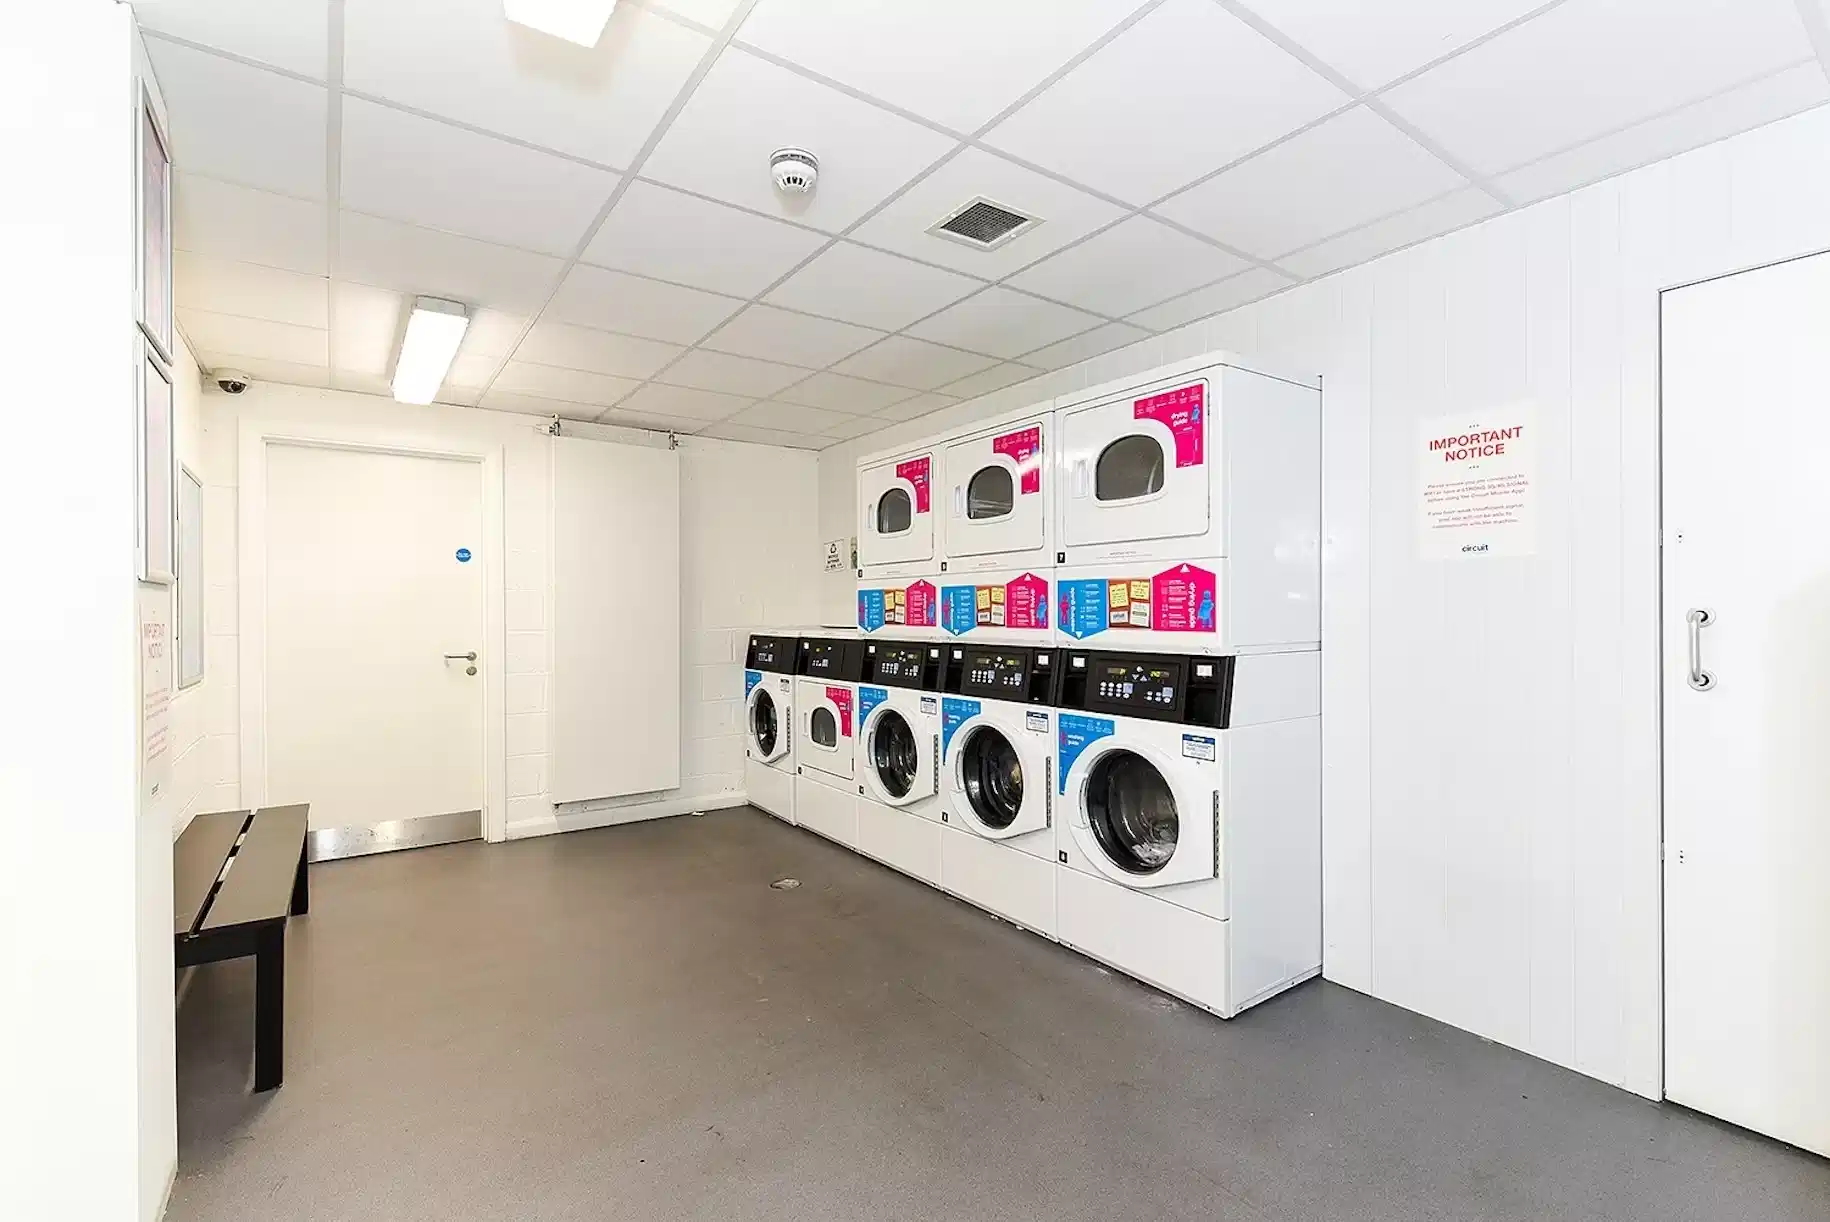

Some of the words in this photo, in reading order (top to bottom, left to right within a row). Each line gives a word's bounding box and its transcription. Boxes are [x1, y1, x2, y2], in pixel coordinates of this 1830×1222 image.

[1429, 426, 1523, 451] IMPORTANT
[1445, 443, 1505, 462] NOTICE
[1461, 544, 1489, 552] circuit
